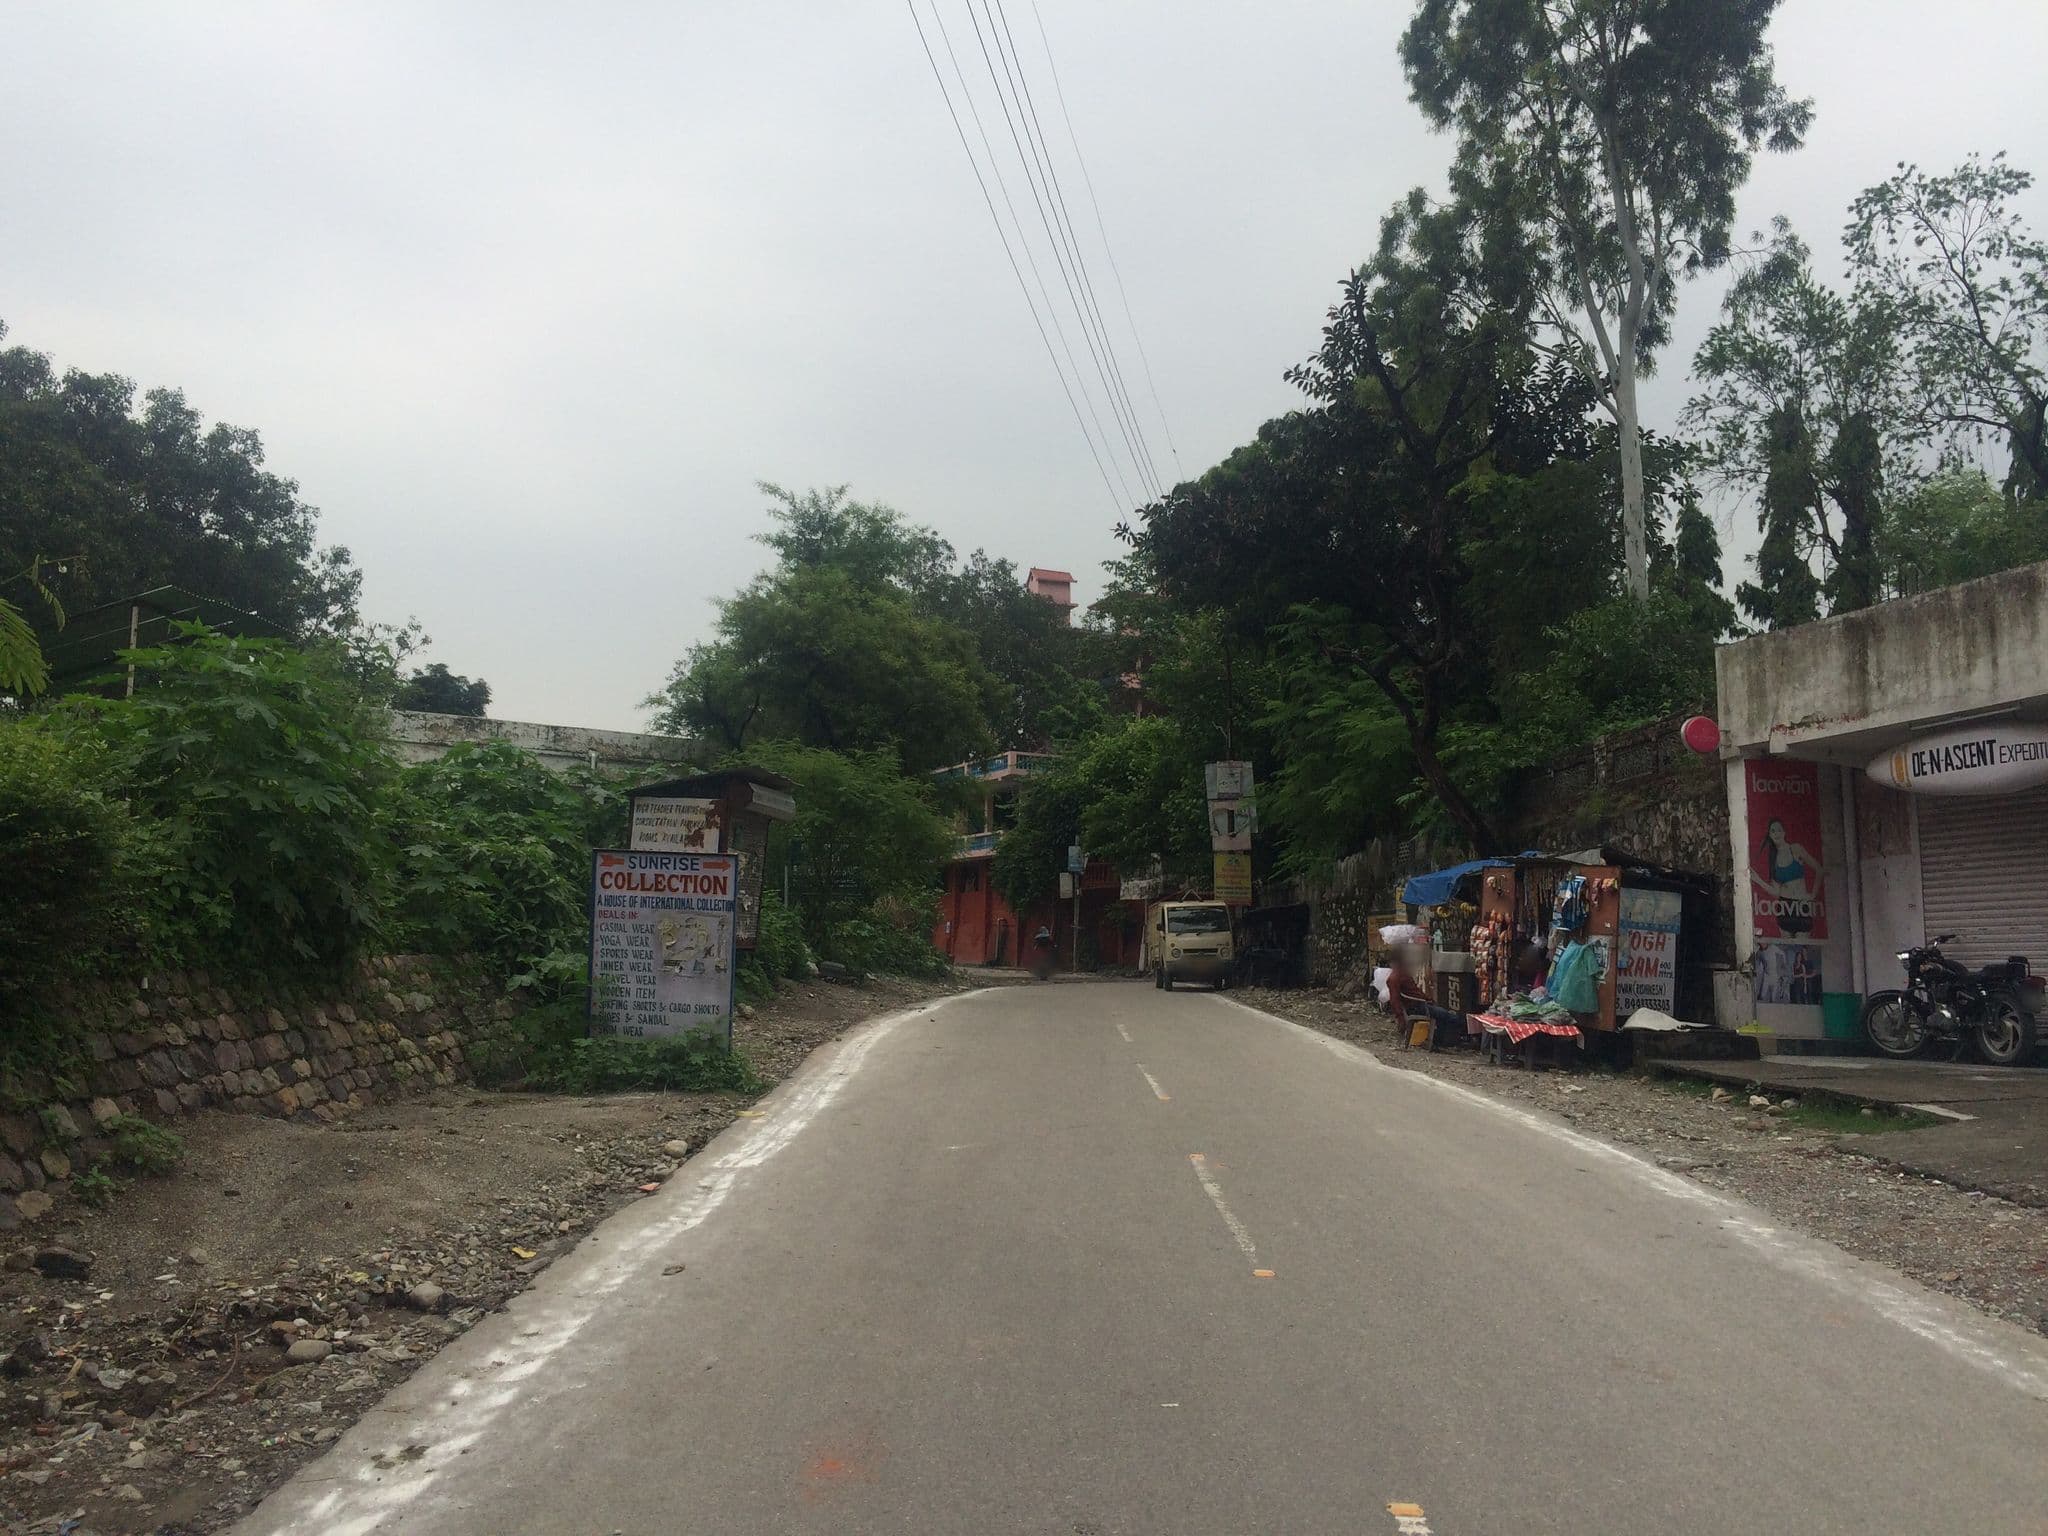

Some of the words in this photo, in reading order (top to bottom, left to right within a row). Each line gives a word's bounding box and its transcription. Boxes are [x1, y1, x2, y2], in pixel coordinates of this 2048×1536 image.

[1912, 739, 1997, 777] DE-N-ASCENT
[628, 855, 700, 872] SUNRISE
[600, 871, 728, 896] COLLECTION
[597, 894, 602, 906] A
[603, 894, 627, 908] HOUSE
[629, 895, 639, 908] OF
[640, 896, 694, 910] INTERNATIONAL
[598, 910, 626, 920] DEALS
[600, 923, 627, 933] CASUAL
[632, 924, 655, 935] WEAR
[600, 935, 621, 947] YOGA
[626, 936, 650, 947] WEAR
[600, 948, 628, 960] SPORTS
[632, 950, 654, 960] WEAR
[600, 961, 624, 971] INNER
[630, 962, 652, 973] WEAR
[636, 975, 656, 986] WEAR
[636, 987, 656, 999] ITEM
[632, 1001, 656, 1013] SHORTS
[669, 1003, 691, 1014] CARGO
[694, 1004, 720, 1016] SHORTS
[638, 1014, 669, 1026] SANDAL
[623, 1026, 643, 1037] WEAR
